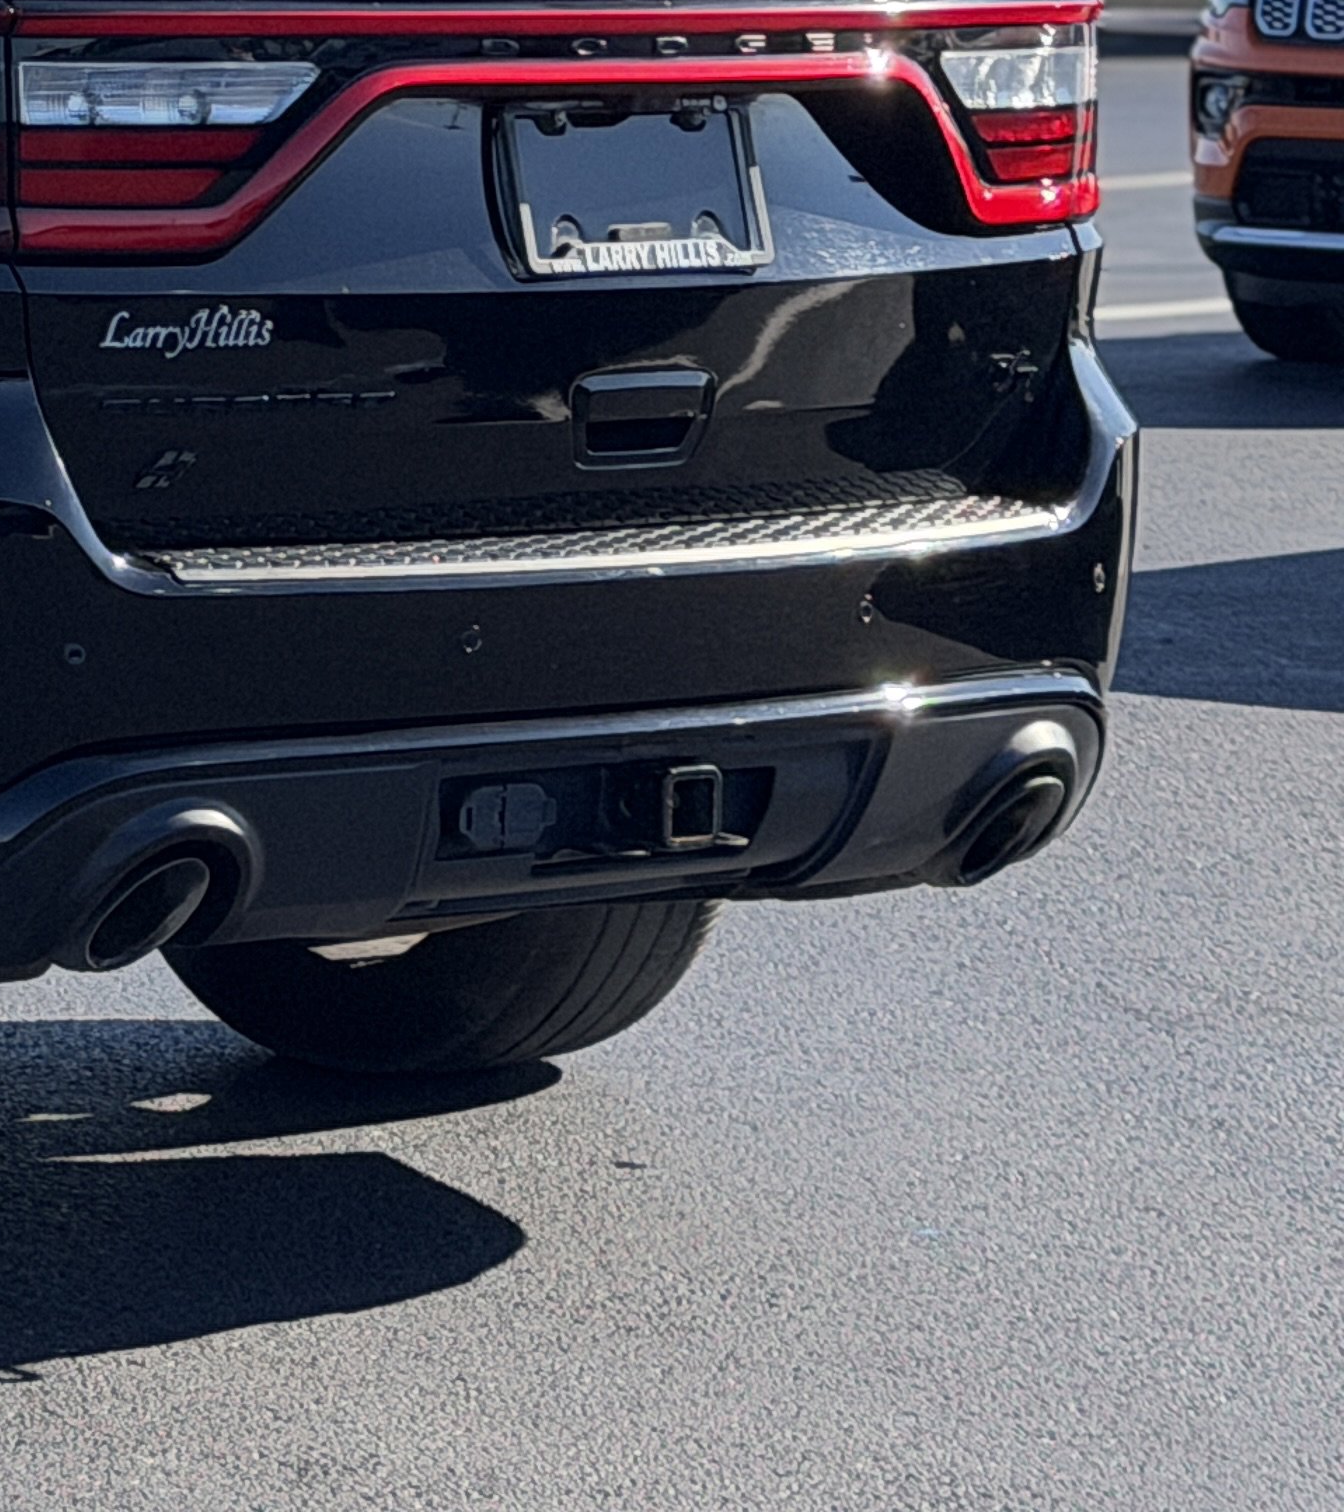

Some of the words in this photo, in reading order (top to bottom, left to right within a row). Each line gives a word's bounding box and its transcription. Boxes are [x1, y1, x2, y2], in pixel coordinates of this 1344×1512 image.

[480, 32, 836, 57] DODGE
[586, 243, 653, 272] LARRY
[656, 240, 720, 269] HILLIS
[99, 304, 274, 359] LarryHillis
